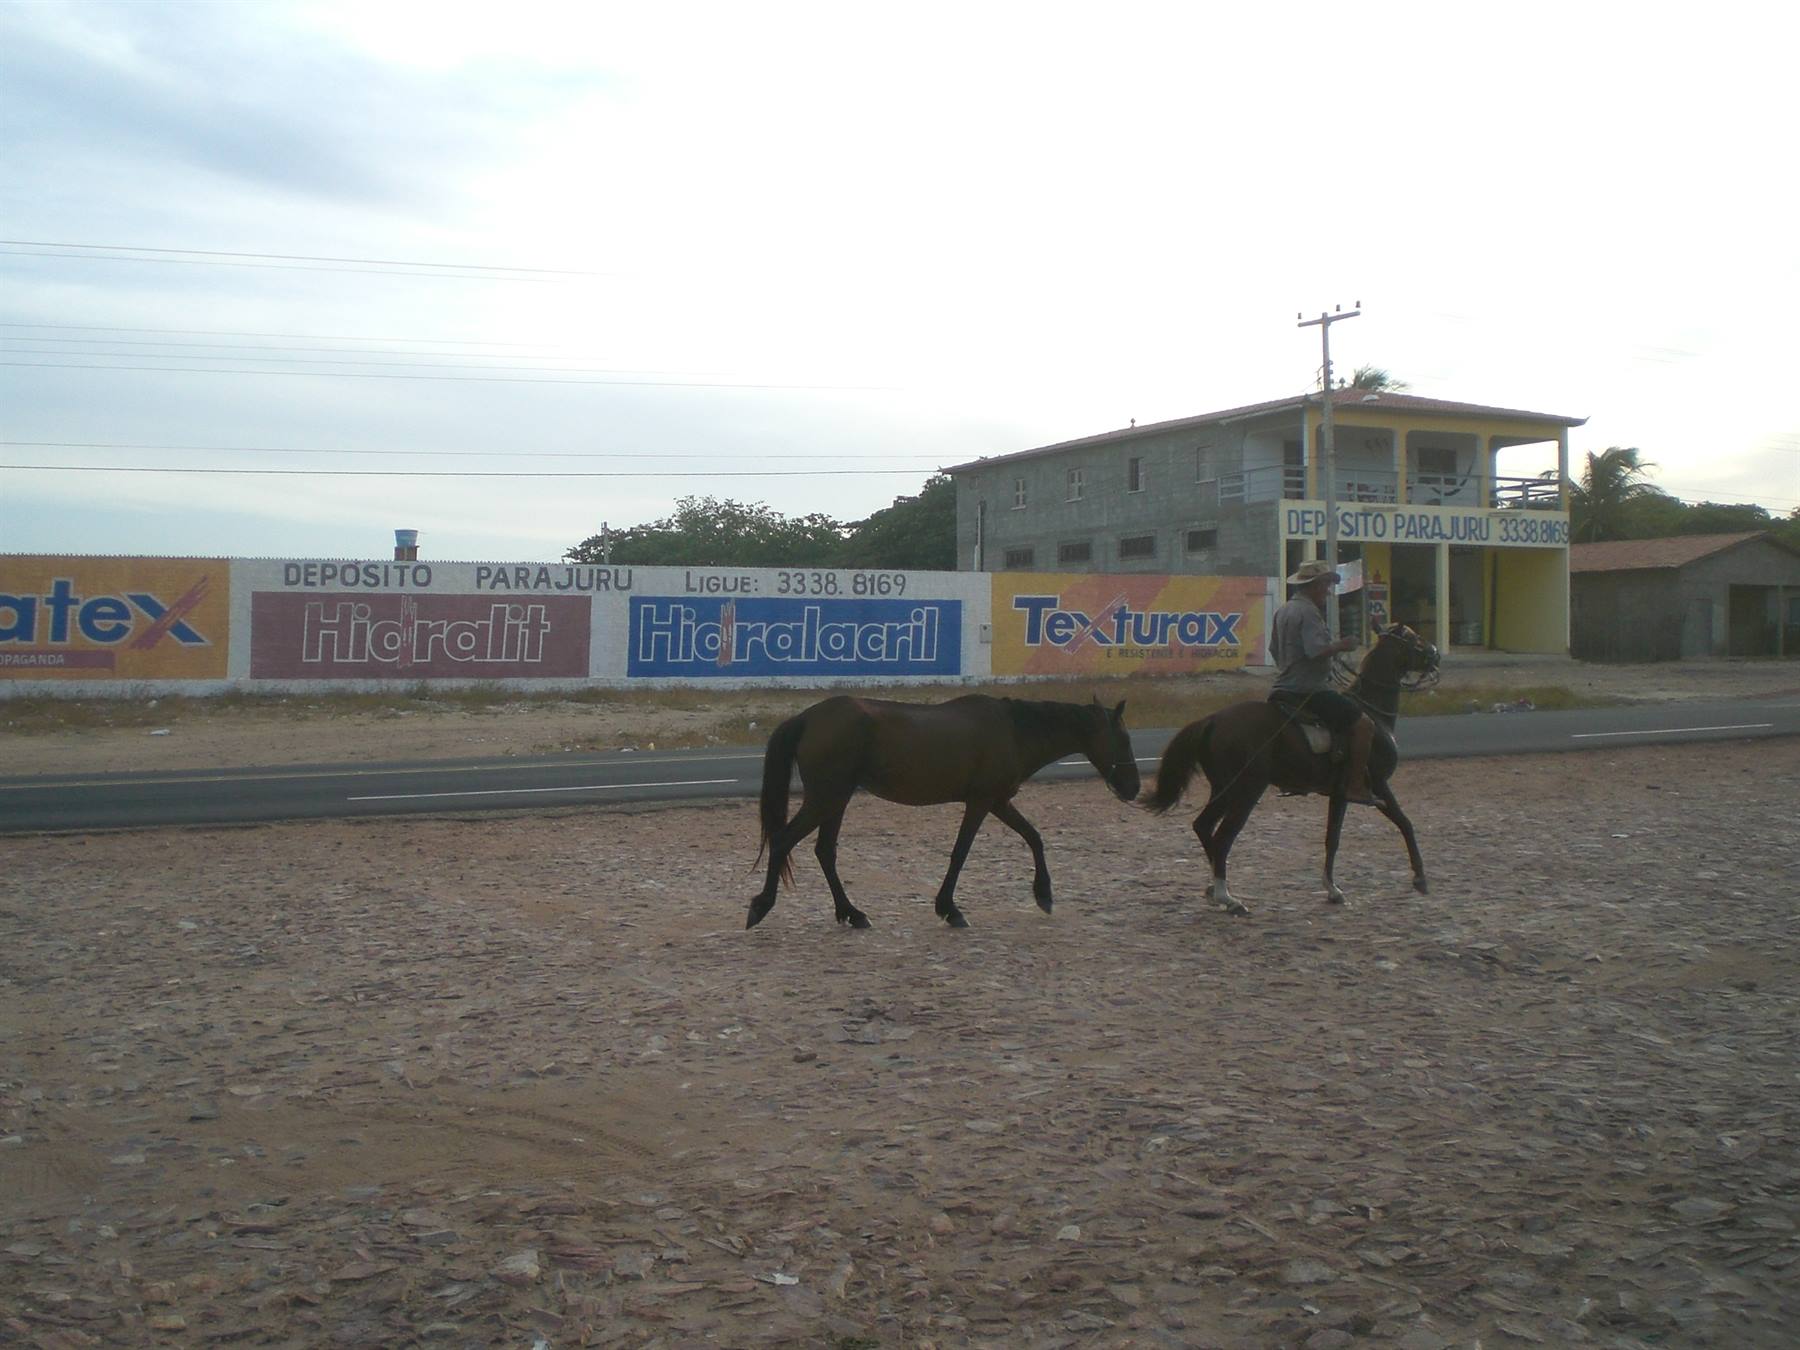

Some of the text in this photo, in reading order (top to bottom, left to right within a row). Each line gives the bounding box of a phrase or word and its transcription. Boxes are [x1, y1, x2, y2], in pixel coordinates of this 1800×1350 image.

[1287, 506, 1387, 538] DEPSITO
[1394, 513, 1490, 541] PARAJURU
[476, 566, 632, 591] PARAJURU
[302, 595, 550, 668] Hidralit
[639, 599, 939, 667] Hidralacril
[1013, 593, 1243, 654] Texturax
